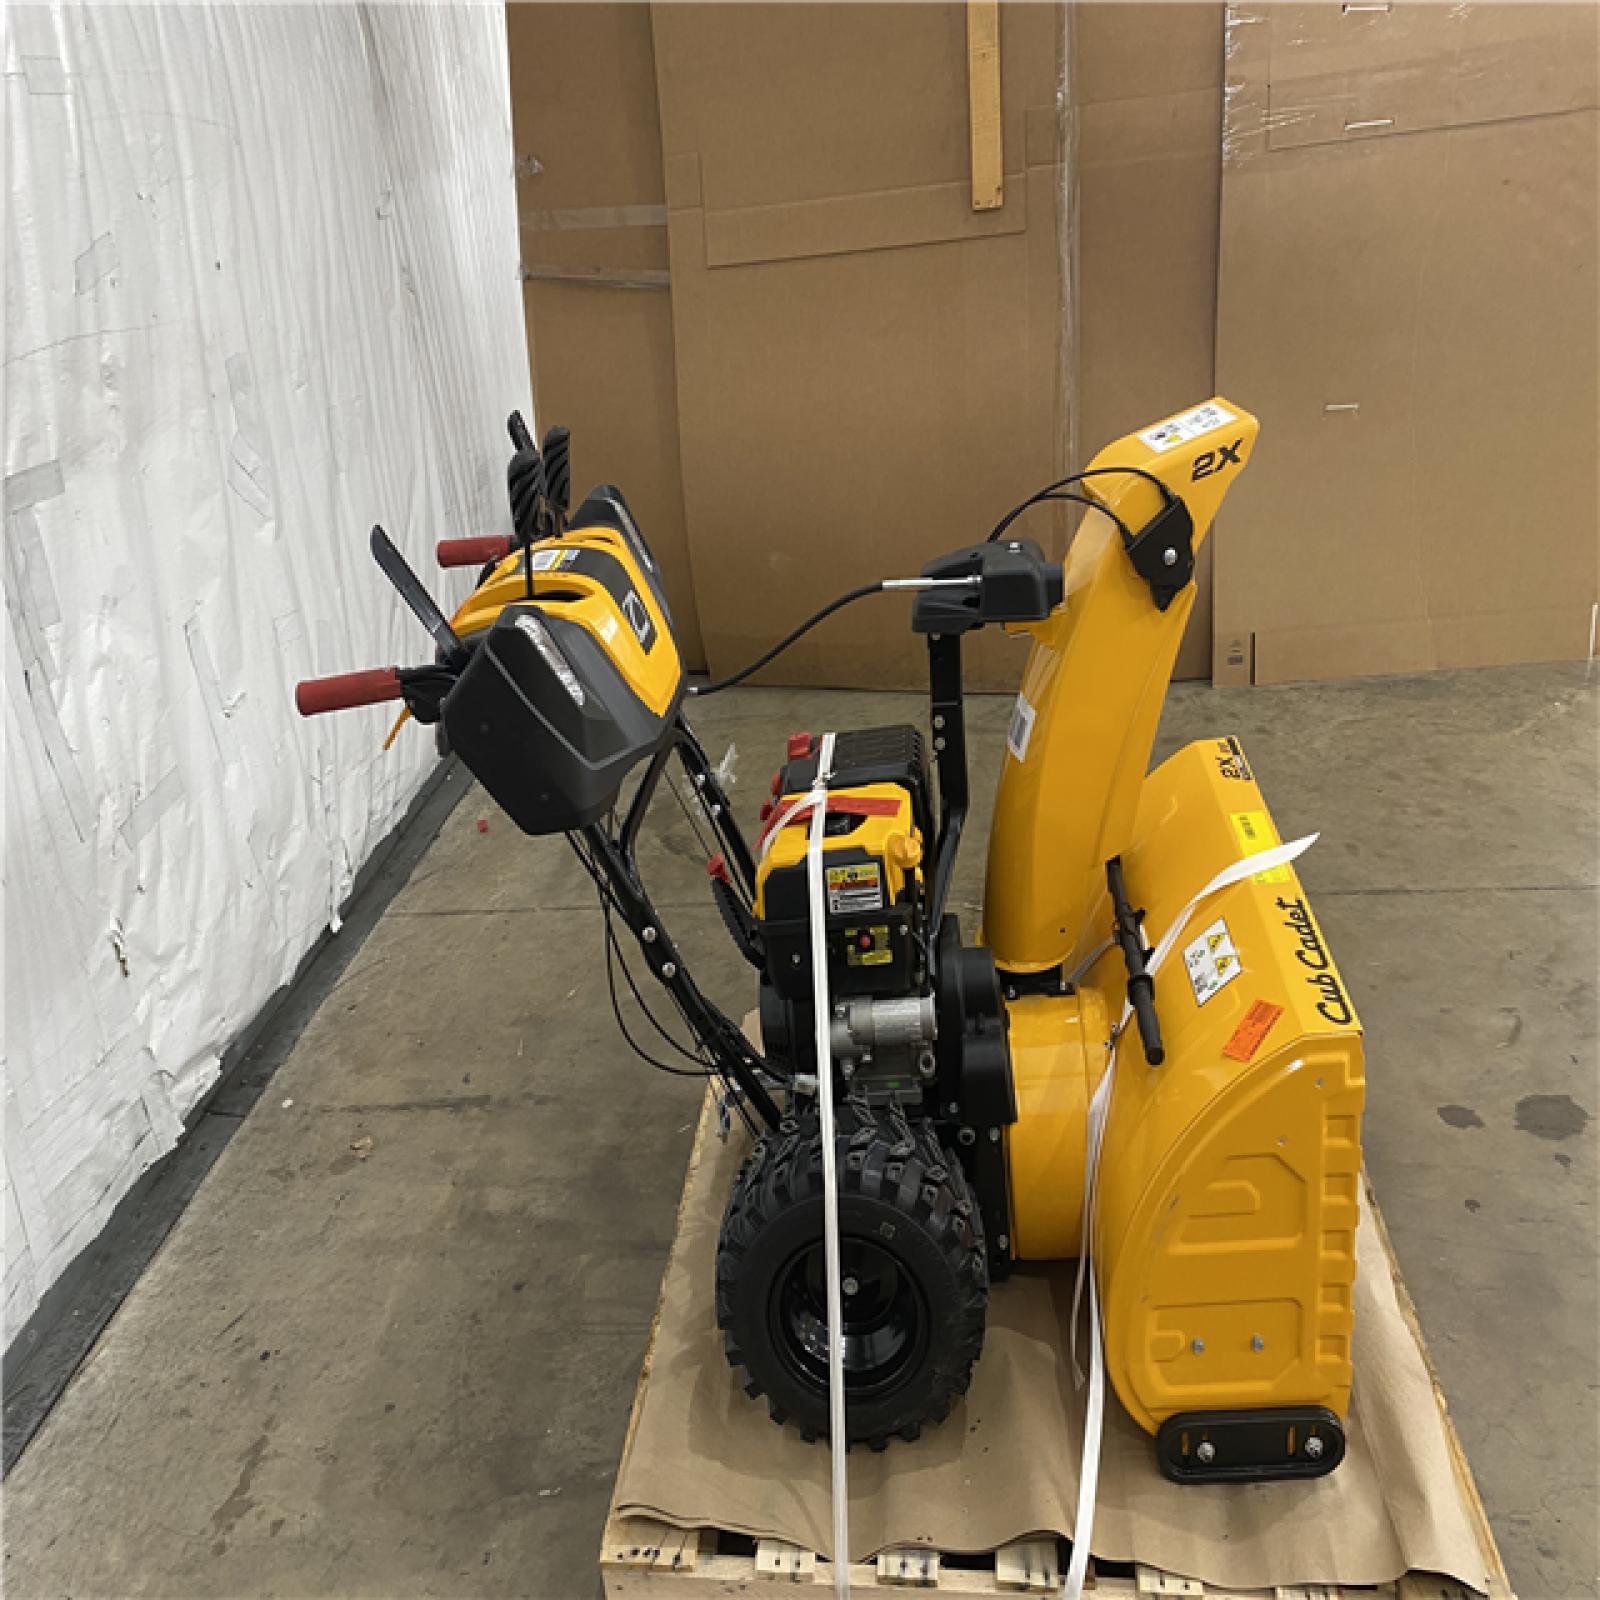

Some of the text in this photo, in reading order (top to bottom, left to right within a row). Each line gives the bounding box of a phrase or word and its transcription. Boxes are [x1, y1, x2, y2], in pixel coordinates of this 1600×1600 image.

[1192, 438, 1243, 481] 2X
[1275, 897, 1352, 1025] Cub Cadet
